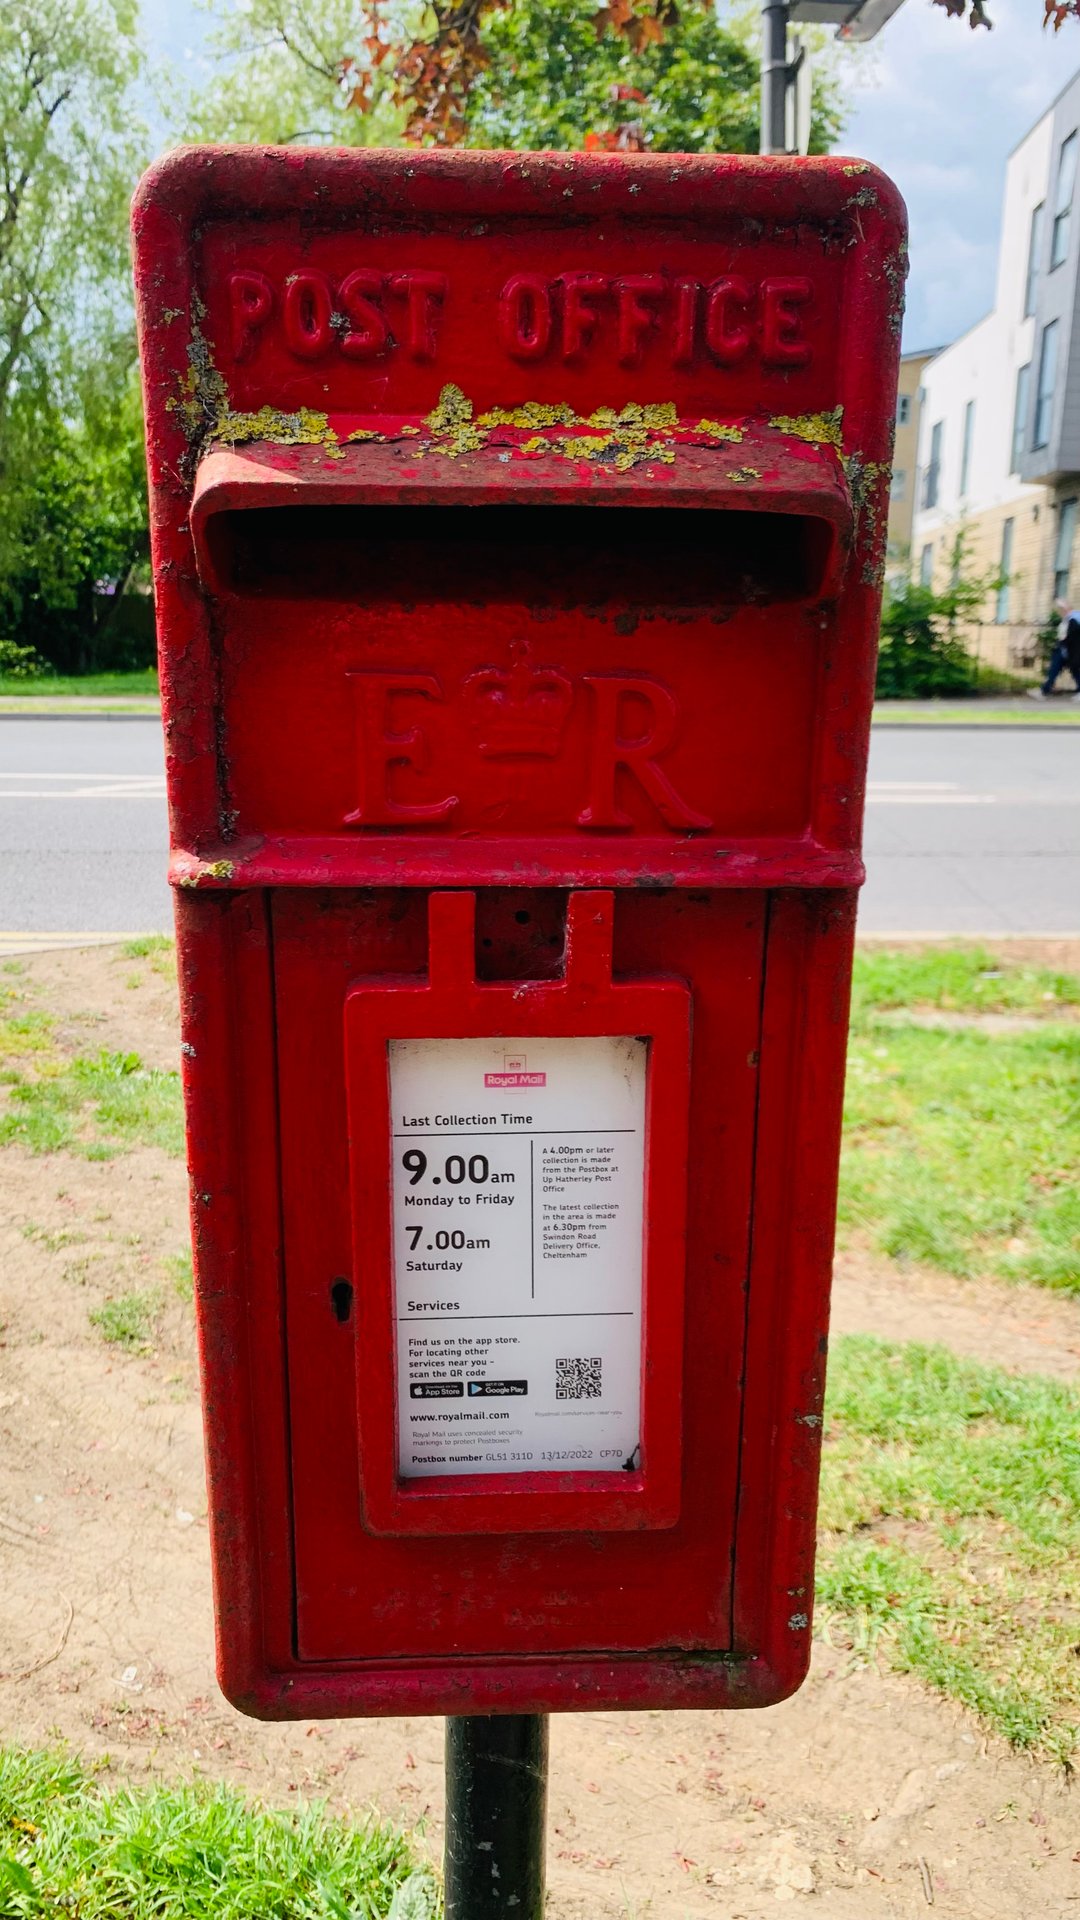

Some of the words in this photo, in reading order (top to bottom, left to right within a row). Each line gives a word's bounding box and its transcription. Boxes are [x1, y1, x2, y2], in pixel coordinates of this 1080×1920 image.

[228, 268, 448, 364] POST
[497, 271, 814, 370] OFFICE
[343, 671, 460, 830] E
[577, 671, 715, 833] R
[488, 1075, 518, 1086] Royal
[520, 1074, 544, 1084] Mail
[402, 1116, 430, 1126] Last
[435, 1114, 497, 1126] Collection
[501, 1113, 533, 1124] Time
[550, 1146, 584, 1154] 4.00pm
[402, 1149, 516, 1186] 9.00am
[404, 1195, 454, 1208] Monday
[458, 1194, 471, 1204] to
[476, 1194, 515, 1206] Friday
[553, 1223, 586, 1232] 6.30pm
[405, 1226, 490, 1250] 7.00am
[406, 1260, 464, 1272] Saturday
[407, 1300, 460, 1312] Services
[476, 1338, 492, 1346] app
[426, 1348, 462, 1357] locating
[471, 1360, 487, 1368] you
[485, 1386, 510, 1394] Google
[510, 1386, 524, 1394] Play
[410, 1412, 510, 1422] www.royalmail.com
[412, 1455, 446, 1464] Postbox
[450, 1454, 482, 1462] number
[486, 1453, 508, 1461] GL51
[541, 1450, 594, 1460] 13/12/2022
